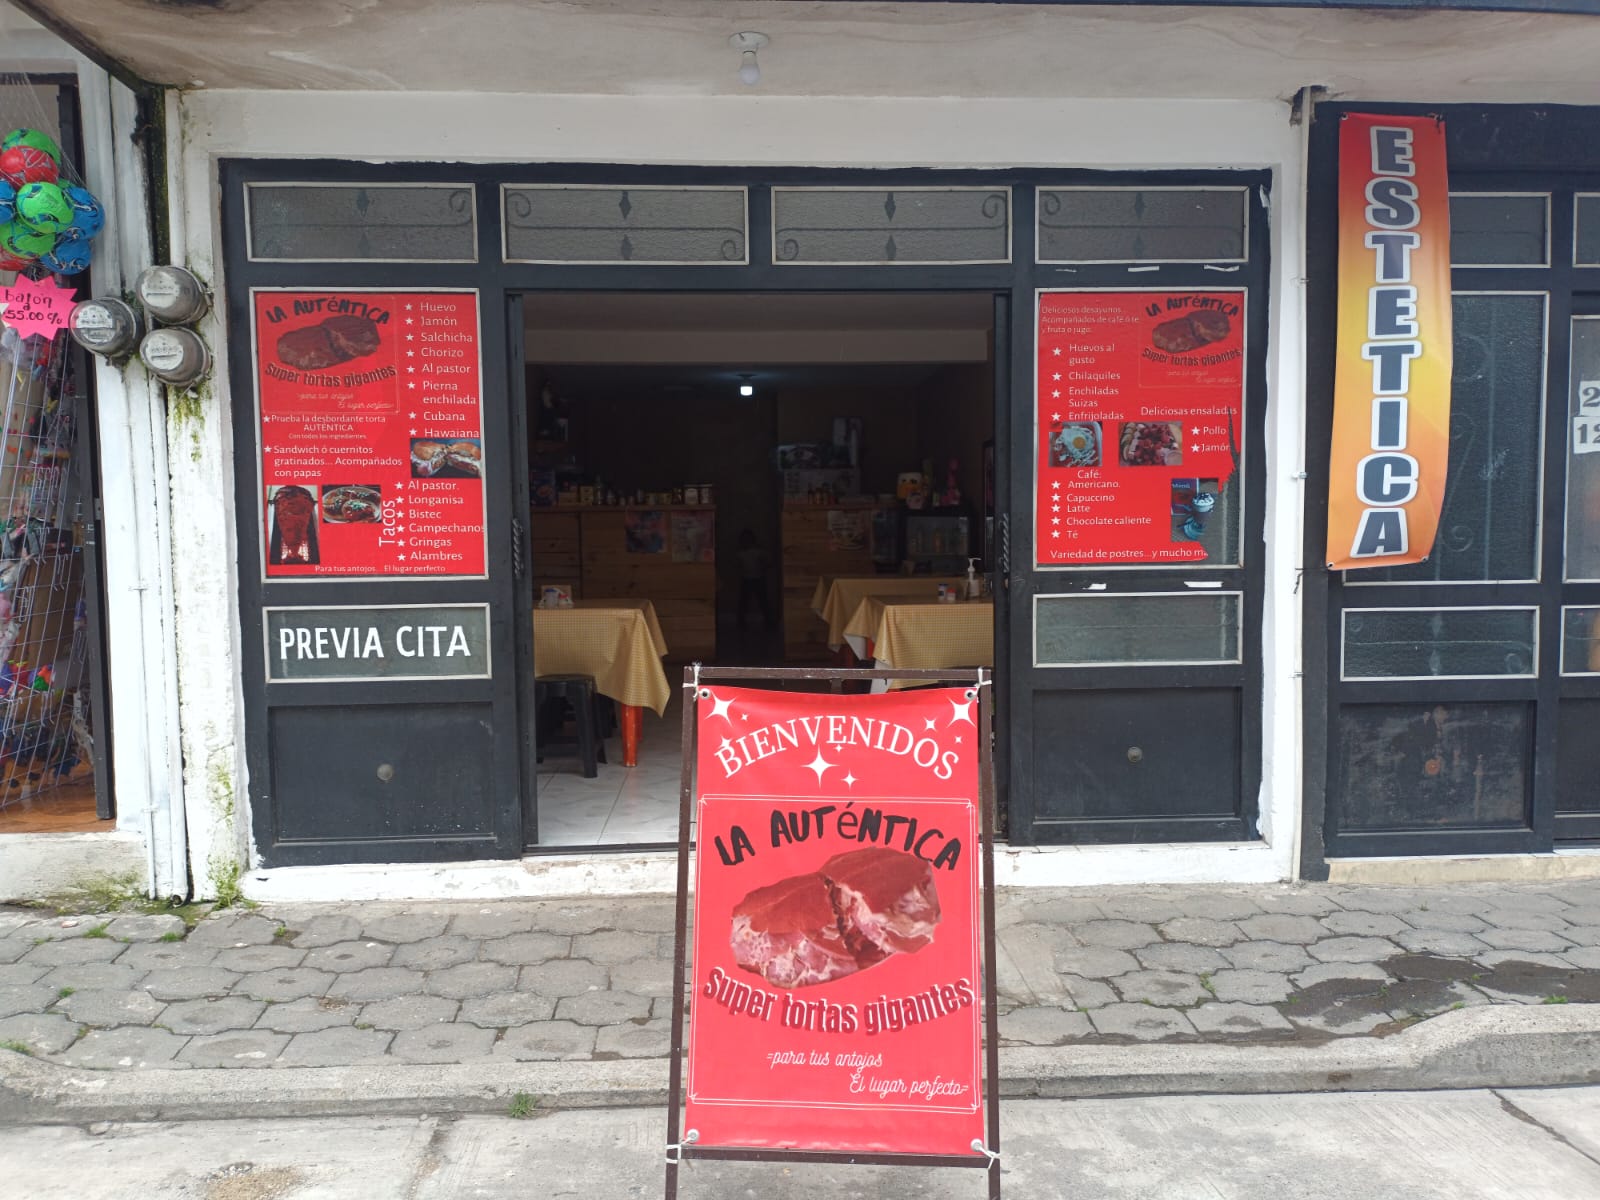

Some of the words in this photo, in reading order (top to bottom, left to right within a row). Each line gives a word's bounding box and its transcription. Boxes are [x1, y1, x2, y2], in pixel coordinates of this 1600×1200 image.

[420, 302, 456, 312] Huevo
[1042, 306, 1080, 314] Deliciosos
[1146, 304, 1162, 317] LA
[266, 306, 287, 323] LA
[420, 316, 458, 327] Jamón
[420, 332, 473, 342] Salchicha
[1350, 125, 1422, 559] ESTETICA
[1069, 343, 1104, 352] Huevos
[1106, 343, 1114, 352] al
[421, 348, 464, 358] Chorizo
[1142, 348, 1169, 364] Super
[1170, 354, 1200, 366] tortas
[1202, 348, 1242, 366] gigantes
[1069, 356, 1095, 366] gusto
[422, 364, 434, 374] Al
[436, 364, 471, 376] pastor
[265, 363, 300, 384] Super
[304, 373, 340, 388] tortas
[344, 364, 397, 388] gigantes
[1068, 371, 1120, 382] Chilaquiles
[423, 380, 458, 391] Pierna
[1069, 386, 1119, 396] Enchiladas
[423, 394, 476, 405] enchilada
[1068, 399, 1098, 408] Suizas
[1140, 406, 1188, 416] Deliciosas
[1190, 406, 1237, 416] ensaladas
[272, 414, 301, 422] Prueba
[302, 414, 310, 422] la
[312, 414, 364, 422] desbordante
[424, 411, 465, 422] Cubana
[1068, 412, 1124, 422] Enfrijoladas
[424, 428, 480, 438] Hawaiana
[1203, 426, 1226, 435] Pollo
[274, 445, 319, 454] Sandwich
[330, 446, 373, 454] cuernitos
[335, 456, 402, 468] Acompañados
[294, 470, 322, 478] papas
[408, 480, 419, 490] Al
[408, 495, 464, 507] Longanisa
[1067, 493, 1115, 504] Capuccino
[1067, 504, 1090, 513] Latte
[409, 509, 441, 519] Bistec
[379, 500, 396, 547] Tacos
[1066, 516, 1113, 526] Chocolate
[1114, 516, 1152, 524] caliente
[1067, 530, 1079, 539] Té
[410, 537, 452, 550] Gringas
[410, 551, 463, 561] Alambres
[1050, 550, 1093, 558] Variedad
[1095, 549, 1108, 558] de
[1160, 548, 1192, 557] mucho
[392, 564, 412, 574] lugar
[414, 564, 446, 573] perfecto
[280, 627, 384, 660] PREVIA
[396, 625, 472, 658] CITA
[714, 715, 959, 780] BIENVENIDOS
[714, 825, 756, 866] LA
[702, 966, 778, 1022] Super
[780, 992, 858, 1033] tortas
[864, 978, 976, 1036] gigantes
[809, 1050, 830, 1066] tus
[835, 1051, 883, 1072] antojos
[849, 1073, 866, 1094] El
[868, 1078, 908, 1100] lugar
